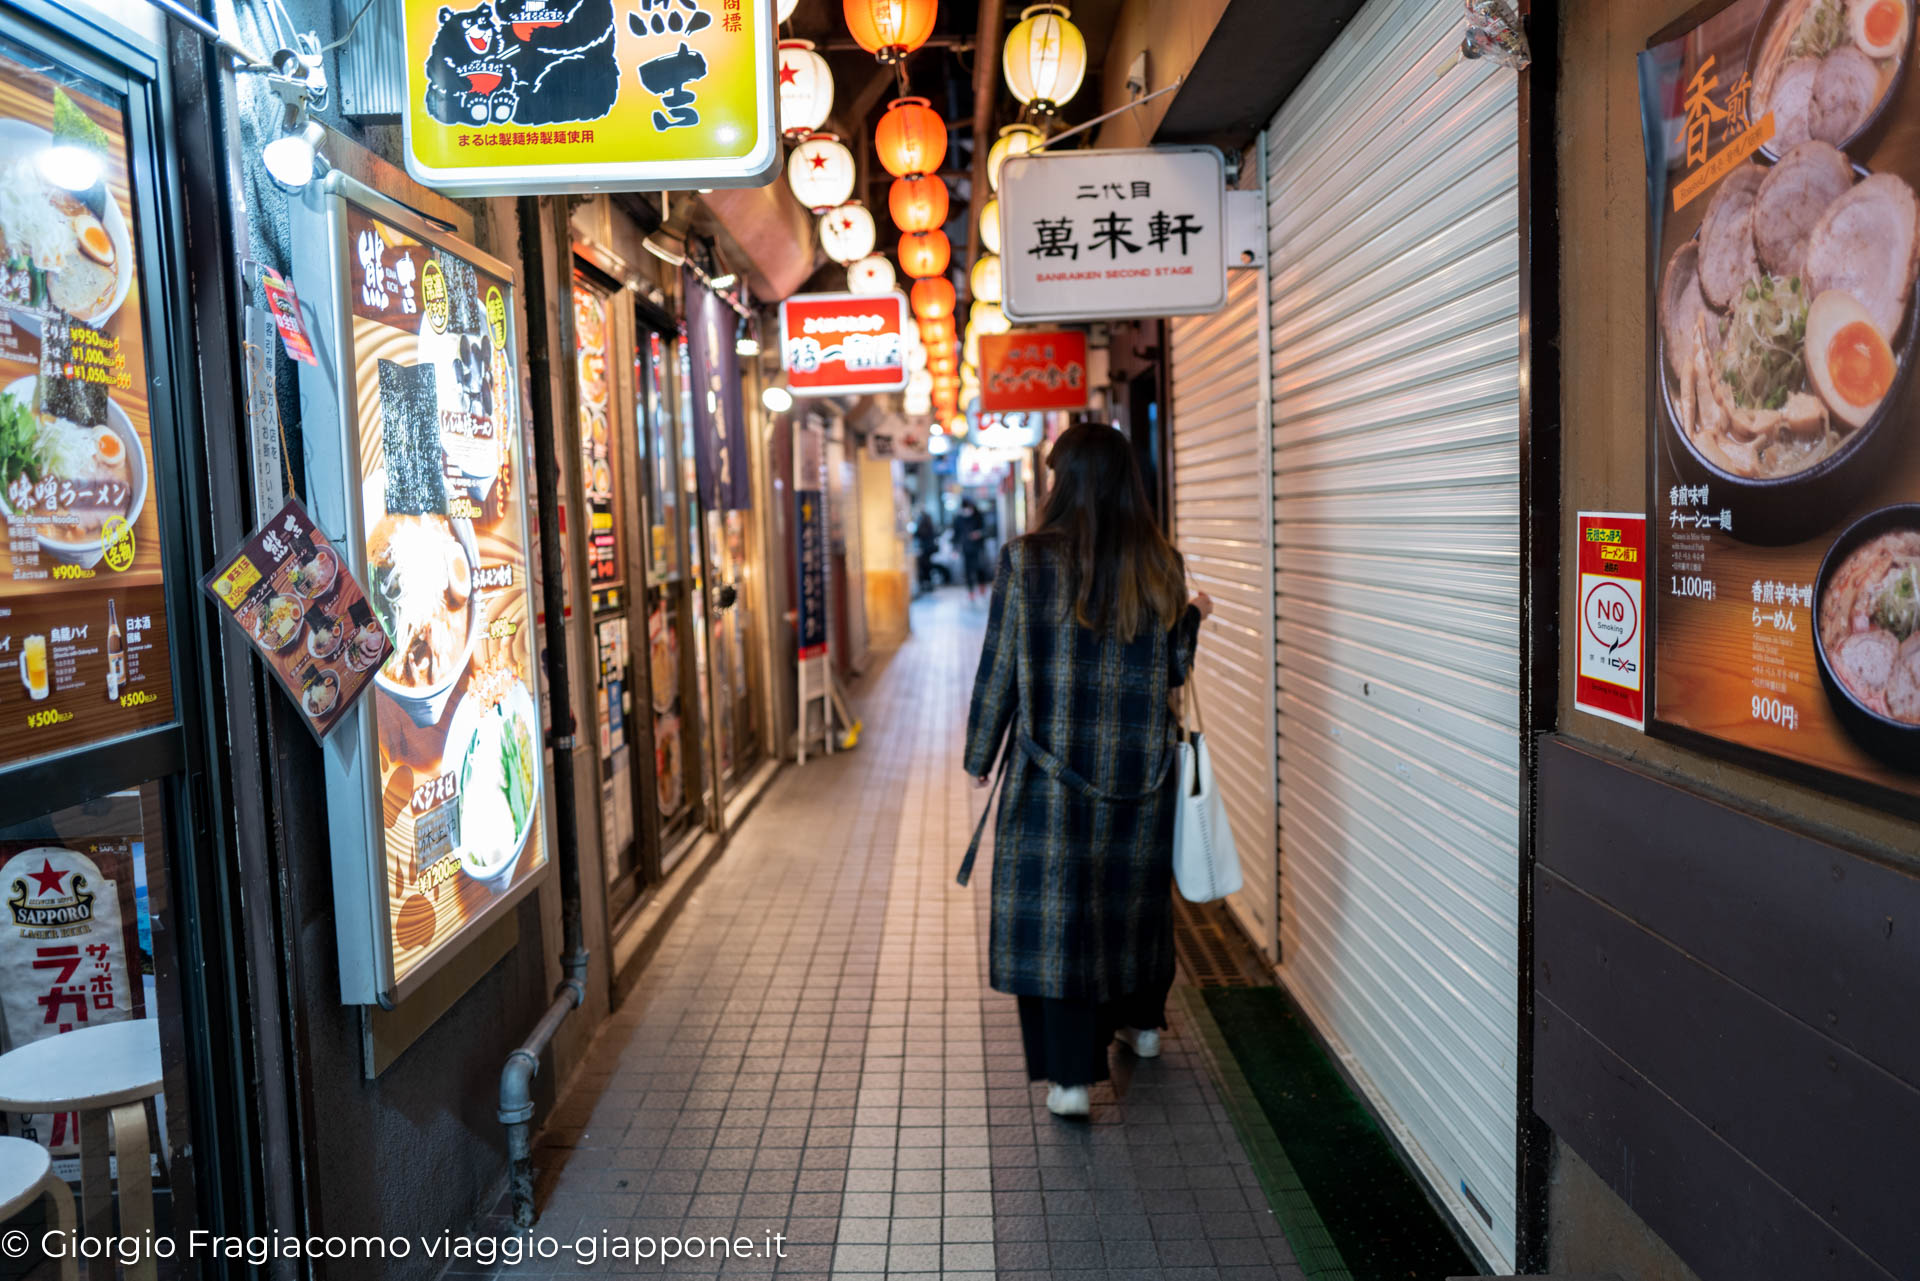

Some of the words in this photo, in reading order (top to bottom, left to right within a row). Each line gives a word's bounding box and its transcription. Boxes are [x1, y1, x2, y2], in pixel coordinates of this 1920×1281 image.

[1674, 55, 1752, 168] 香煎
[458, 130, 594, 147] まるは製麺特製麺使用
[1076, 181, 1151, 199] 二代目
[1027, 211, 1203, 260] 萬来軒
[1036, 271, 1101, 282] BANRAIKEN
[1105, 268, 1151, 279] SECOND
[1155, 265, 1193, 277] STAGE
[8, 472, 126, 511] 味噌ラーメン
[1669, 484, 1709, 506] 香煎味噌
[1669, 509, 1732, 531] チャーシュー麺
[1602, 546, 1636, 562] ラーメン横丁
[1671, 575, 1712, 600] 1,100円
[1751, 580, 1812, 608] 香煎辛味噌
[126, 616, 152, 631] 日本酒
[1597, 622, 1624, 635] Smoking
[1751, 608, 1797, 633] らーめん
[120, 691, 145, 708] ¥500
[28, 709, 58, 729] ¥500
[1752, 694, 1795, 731] 900円
[17, 904, 89, 925] SAPPORO
[86, 944, 114, 1010] サッポロ
[32, 945, 88, 1034] ラガ
